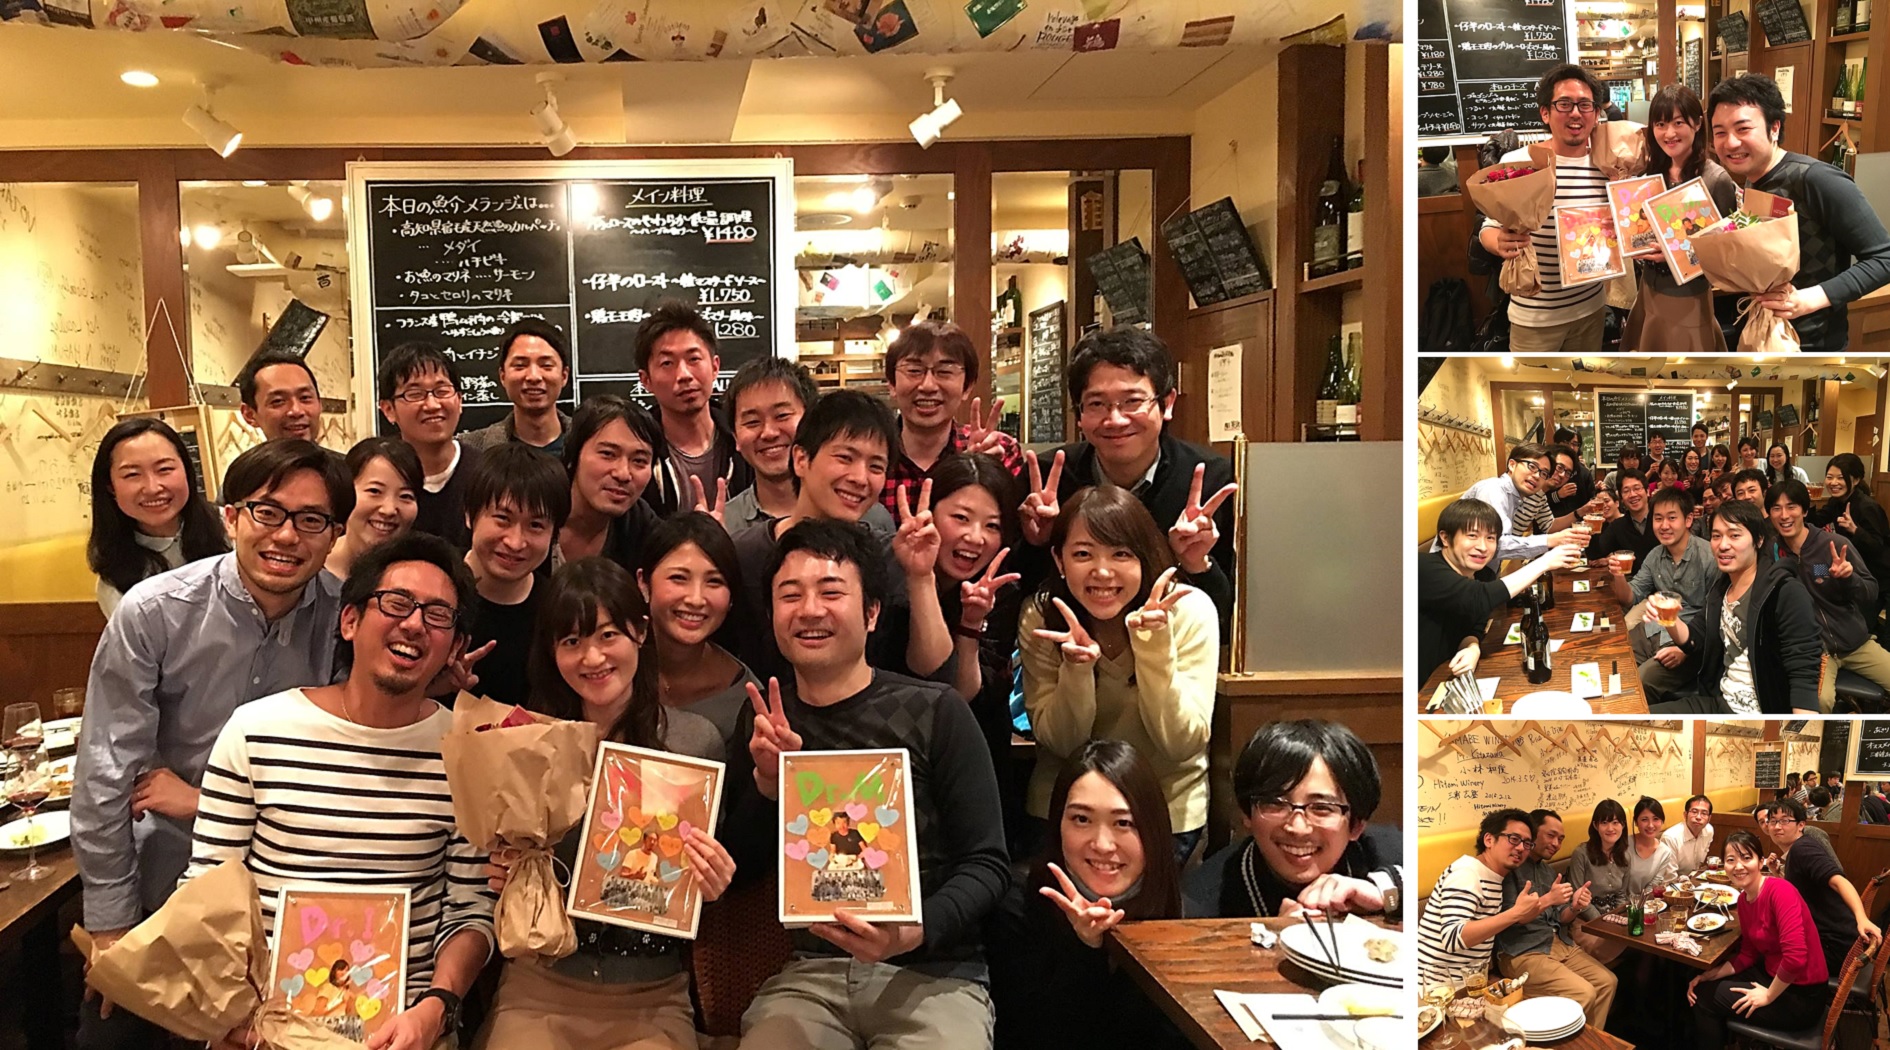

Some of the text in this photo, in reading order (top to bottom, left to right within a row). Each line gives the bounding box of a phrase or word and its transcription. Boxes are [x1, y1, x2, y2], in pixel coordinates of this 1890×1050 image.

[628, 185, 708, 206] メイン料理
[443, 238, 482, 256] メダイ
[458, 252, 508, 268] ハチビキ
[1433, 779, 1459, 790] Hitomi
